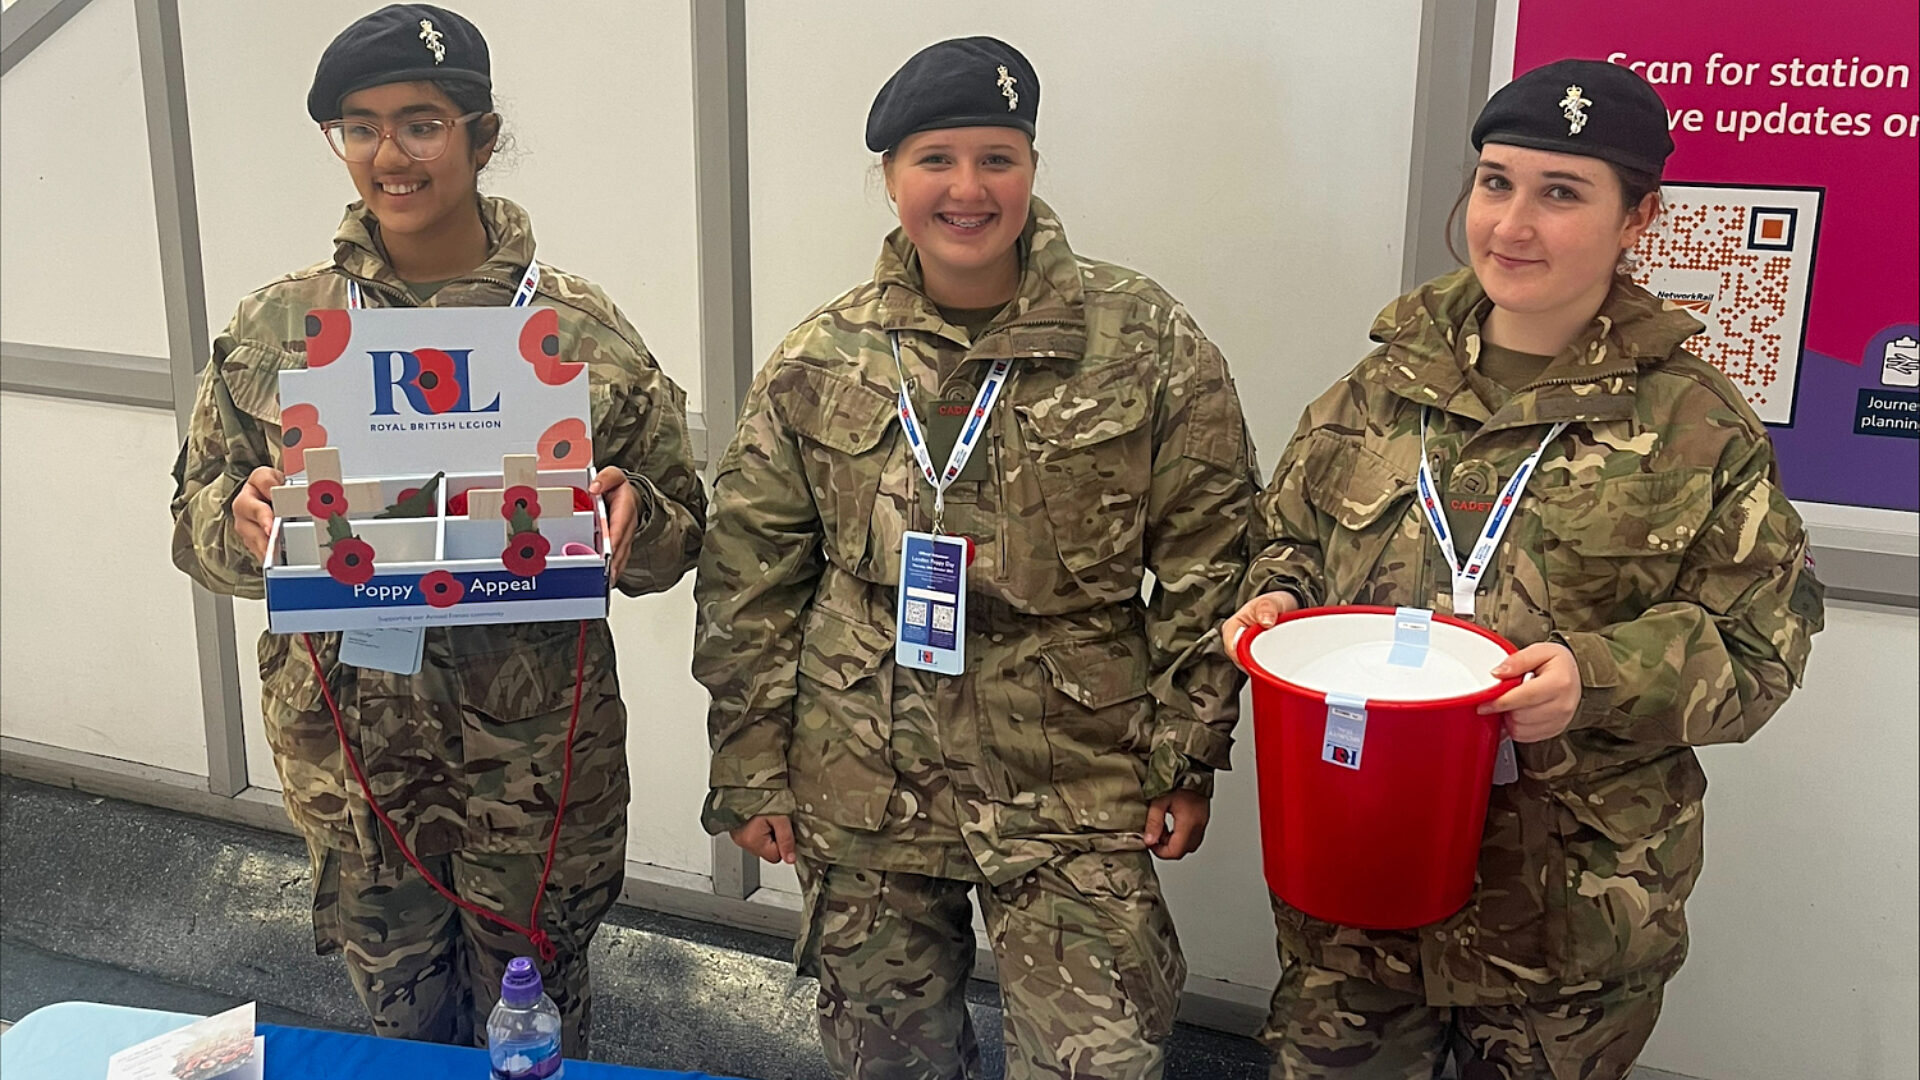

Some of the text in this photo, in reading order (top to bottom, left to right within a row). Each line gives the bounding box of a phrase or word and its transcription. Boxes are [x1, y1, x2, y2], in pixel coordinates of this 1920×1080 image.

[1705, 52, 1760, 86] for
[1769, 57, 1909, 88] station
[1715, 102, 1871, 142] updates
[1867, 396, 1919, 411] Journe
[370, 420, 501, 432] ROYAL BRITISH LEGION
[1861, 414, 1919, 430] plannin
[354, 576, 536, 600] Poppy Appeal
